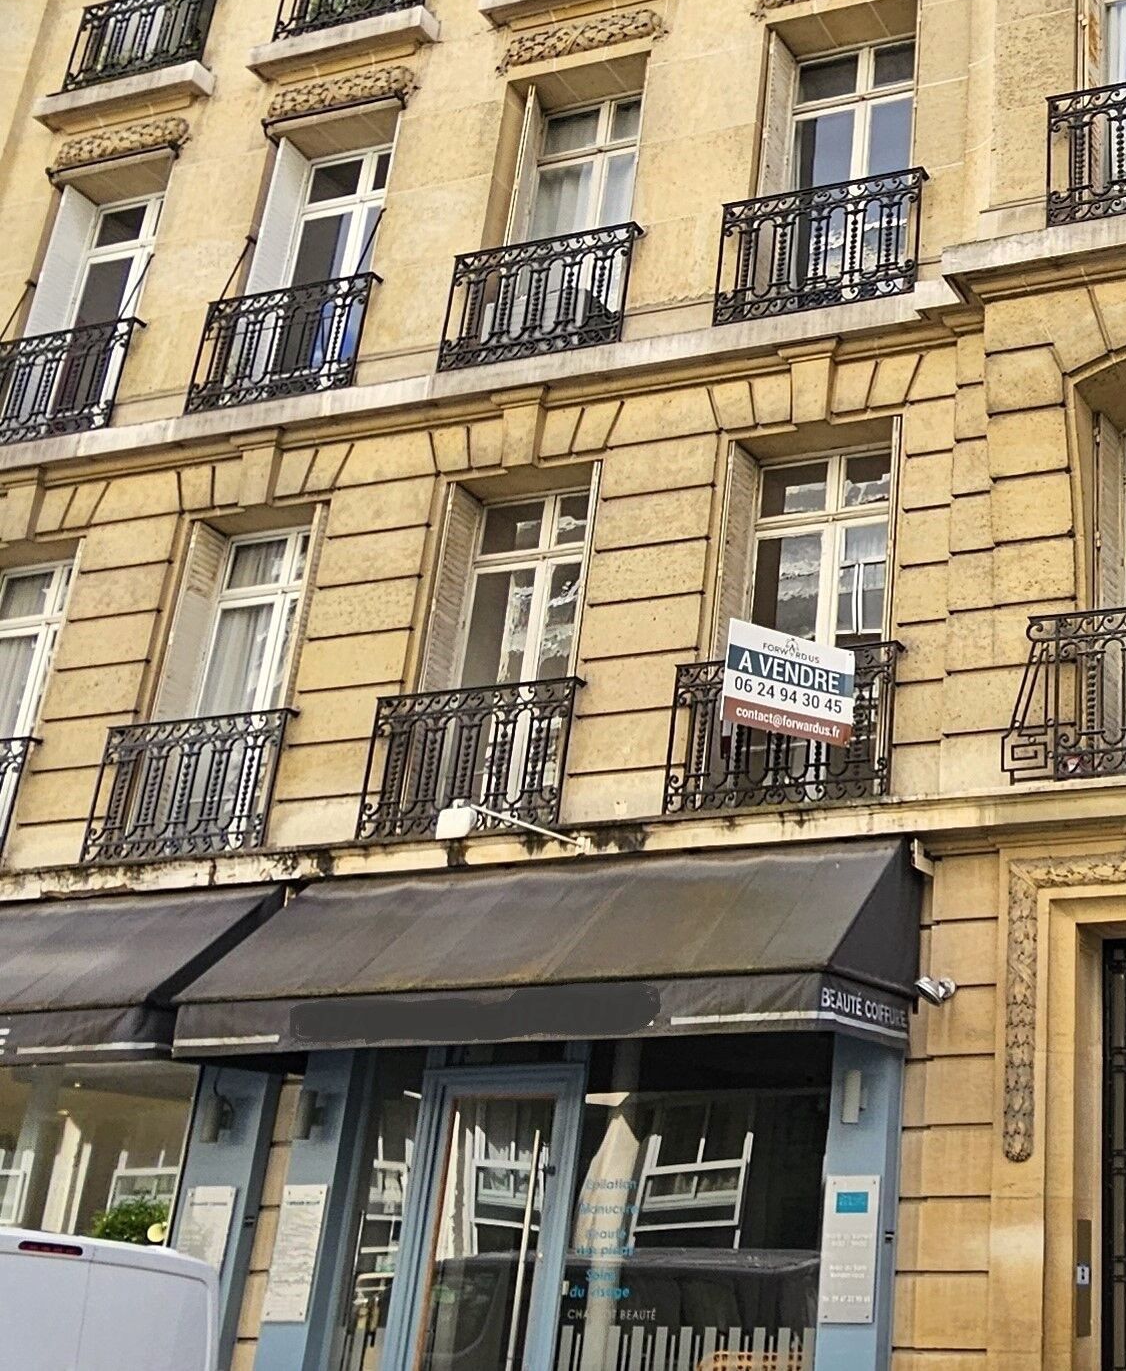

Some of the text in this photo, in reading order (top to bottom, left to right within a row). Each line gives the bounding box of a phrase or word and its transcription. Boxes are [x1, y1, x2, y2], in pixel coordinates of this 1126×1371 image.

[762, 642, 820, 663] FORWARDUS
[738, 650, 840, 694] A VENDRE
[734, 676, 842, 714] 06 24 94 30 45
[736, 706, 840, 738] contact@forwardus.fr
[821, 987, 862, 1016] BEAUTÉ
[569, 1285, 585, 1298] du
[620, 1307, 656, 1320] BEAUTÉ
